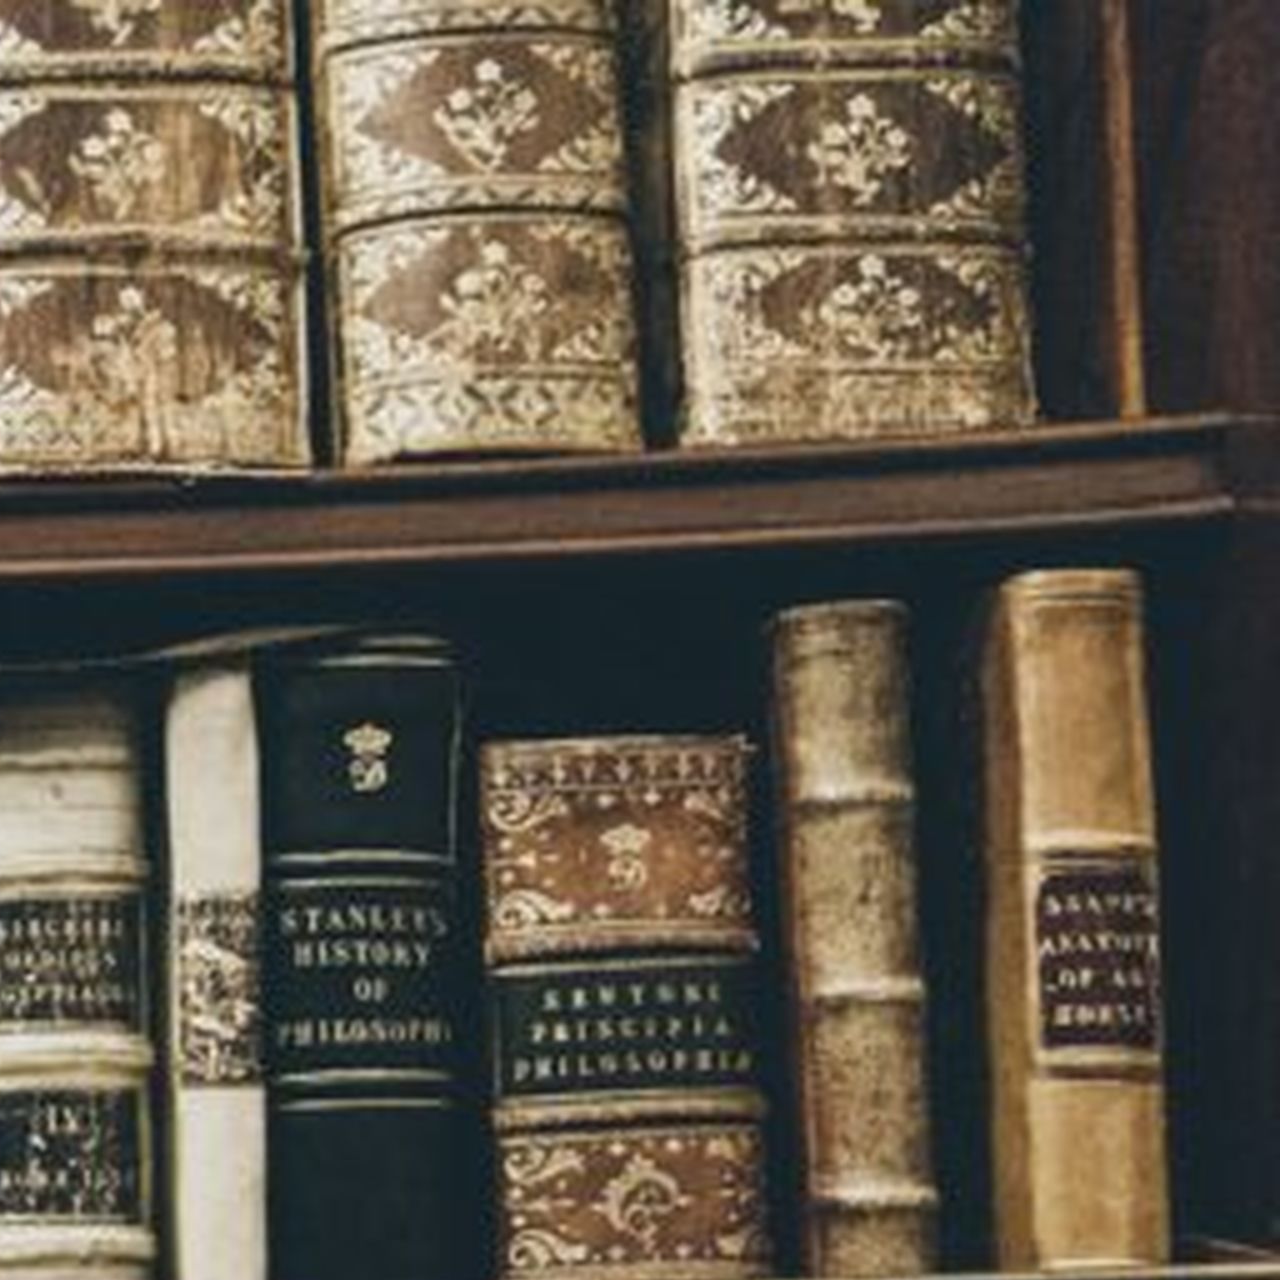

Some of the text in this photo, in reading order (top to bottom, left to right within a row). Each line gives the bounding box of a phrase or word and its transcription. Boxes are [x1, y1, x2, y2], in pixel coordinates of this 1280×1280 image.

[293, 939, 432, 968] HISTORY
[353, 975, 389, 1002] OF
[1058, 968, 1093, 989] OF
[530, 1015, 733, 1044] PRINCIPIA
